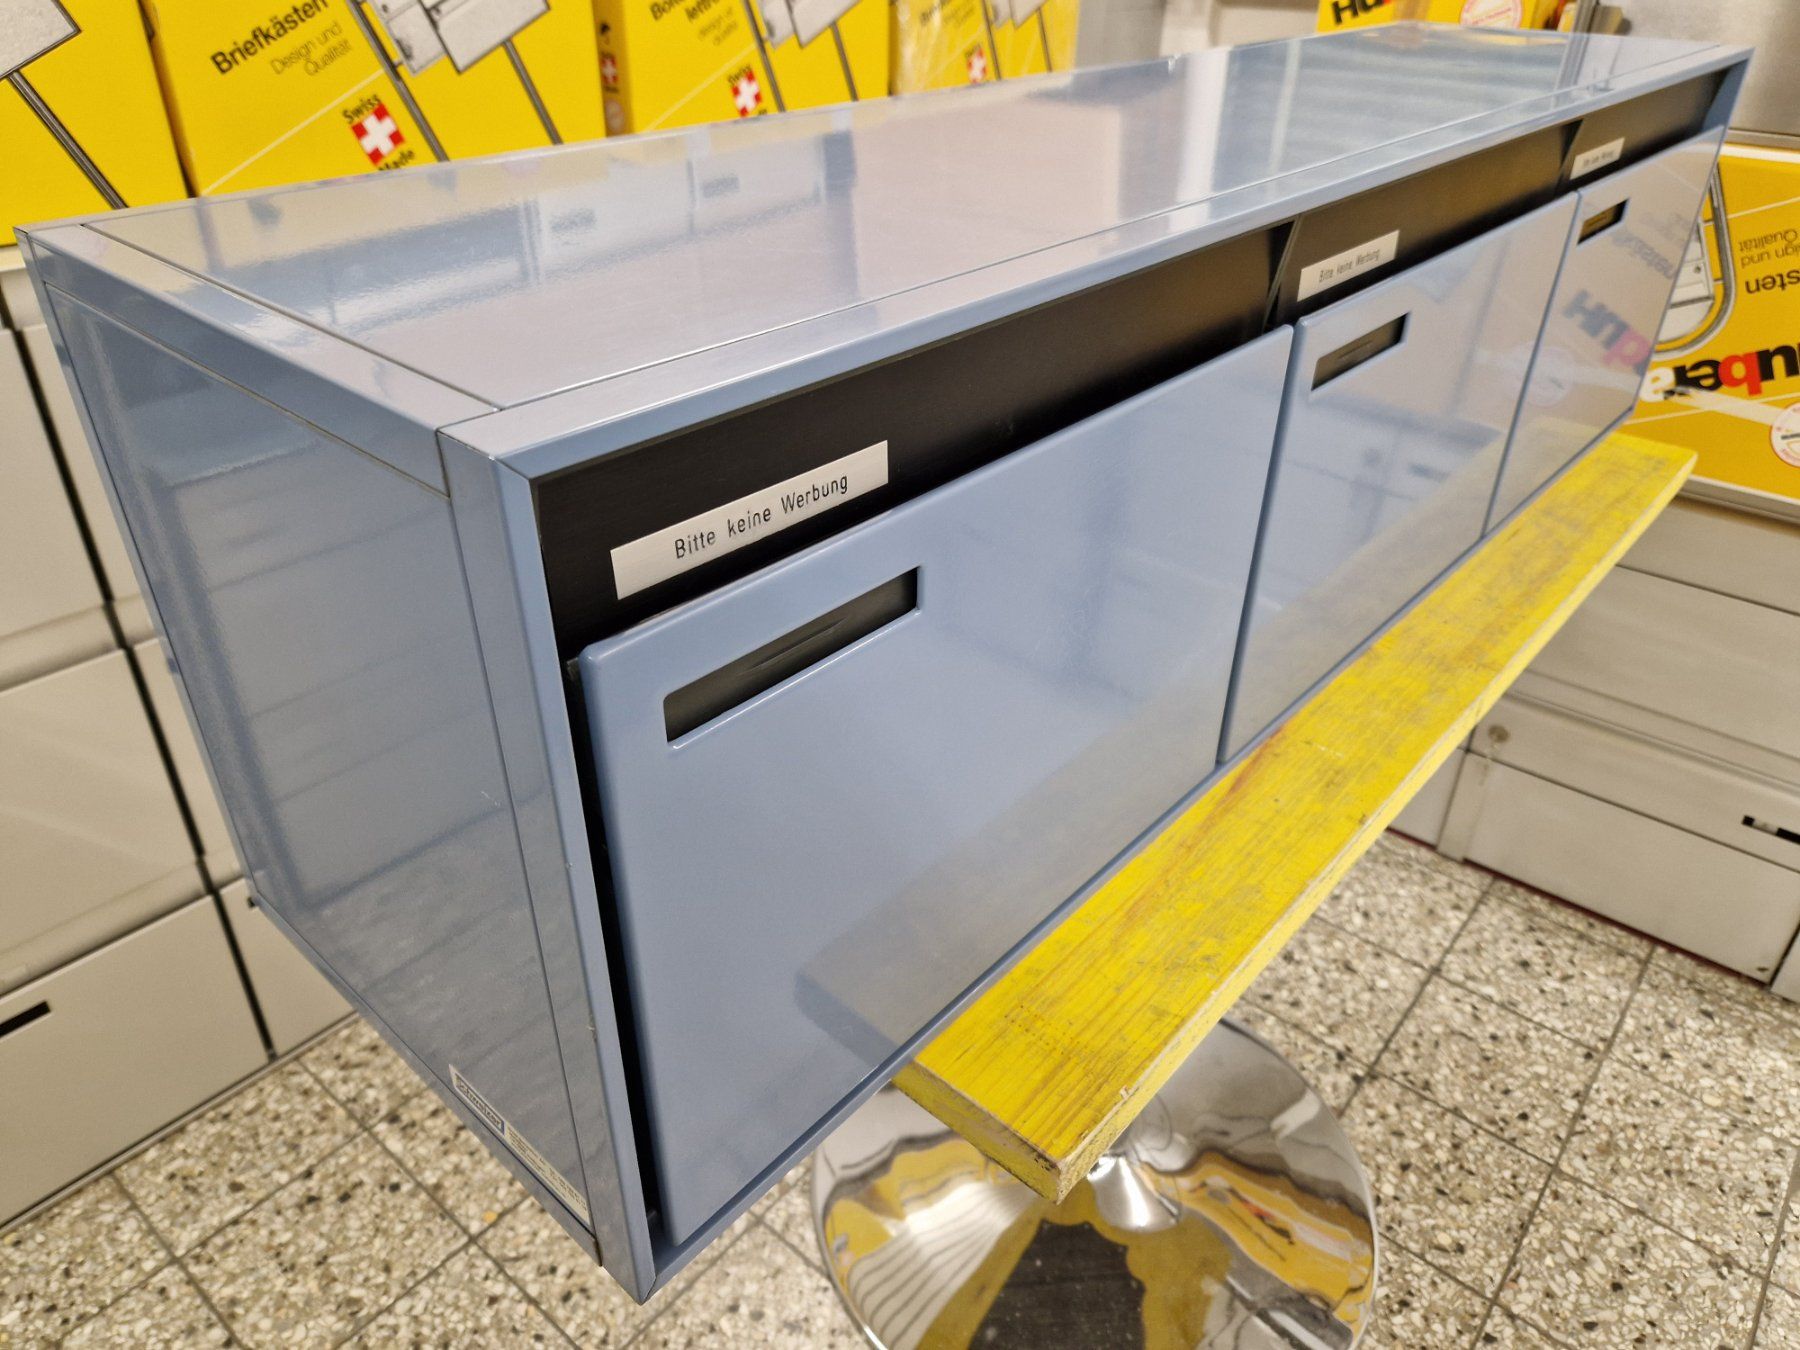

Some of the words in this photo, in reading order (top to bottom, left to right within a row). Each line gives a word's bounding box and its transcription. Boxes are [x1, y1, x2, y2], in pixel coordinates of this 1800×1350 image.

[210, 0, 329, 74] Briefkästen
[270, 40, 318, 75] Design
[317, 20, 343, 47] und
[304, 39, 352, 76] Qualität
[342, 94, 381, 124] Swiss
[1738, 228, 1798, 252] Qualität
[1741, 251, 1771, 269] und
[674, 530, 716, 559] Bitte
[727, 507, 772, 539] keine
[781, 475, 848, 514] Werbung
